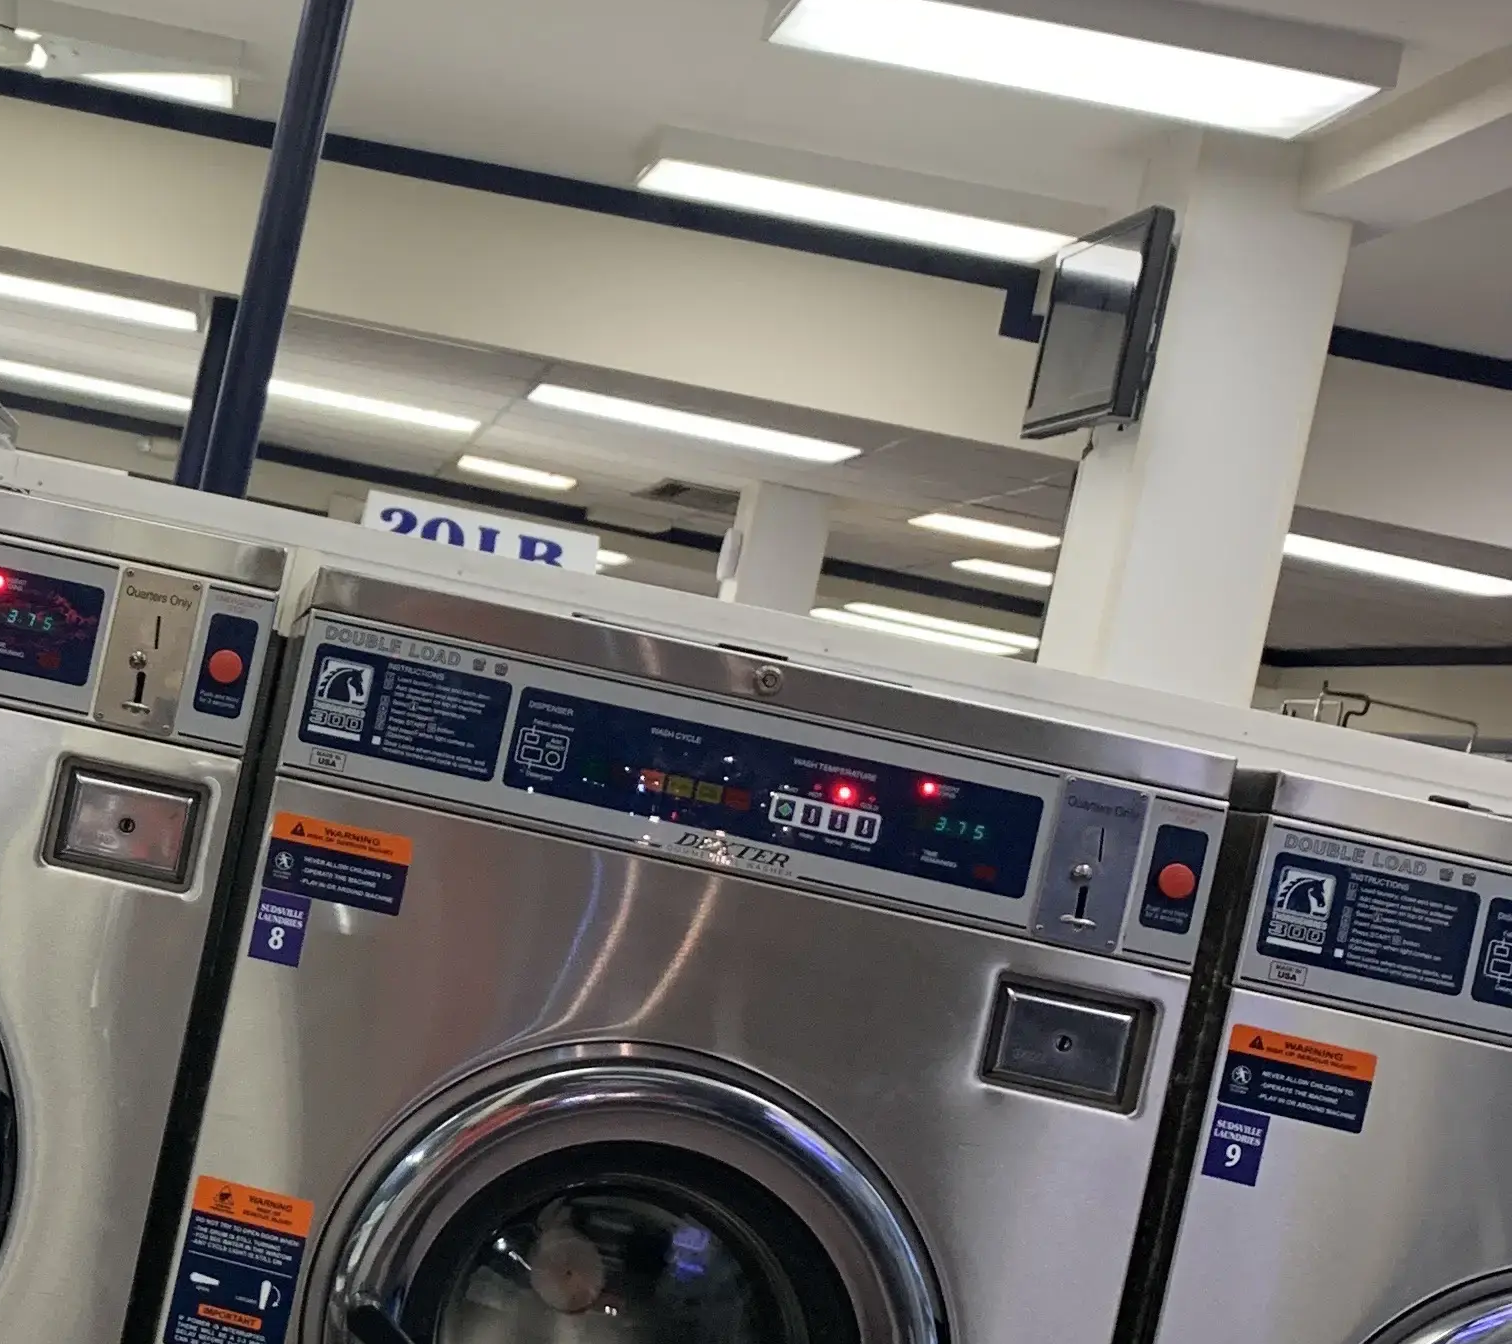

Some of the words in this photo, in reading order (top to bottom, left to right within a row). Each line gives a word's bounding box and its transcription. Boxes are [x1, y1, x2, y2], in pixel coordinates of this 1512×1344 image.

[126, 586, 167, 603] Quarters
[170, 595, 192, 611] Only
[8, 609, 52, 630] 3.75
[326, 626, 402, 655] DOUBLE
[408, 644, 462, 667] LOAD
[388, 662, 444, 680] INSTRUCTIONS
[529, 700, 574, 717] DISPENSER
[309, 709, 363, 733] 300
[652, 728, 674, 738] WASH
[676, 732, 701, 744] CYCLE
[318, 758, 336, 767] USA
[325, 828, 380, 846] WARNING
[1284, 833, 1365, 864] DOUBLE
[1372, 852, 1428, 878] LOAD
[1351, 873, 1410, 891] INSTRUCTIONS
[258, 912, 303, 929] LAUNDRIES
[261, 904, 303, 919] SUDSVILLE
[267, 926, 286, 950] 8
[1278, 971, 1297, 981] USA
[1286, 1041, 1343, 1060] WARNING
[1262, 1071, 1284, 1080] NEVER
[1285, 1076, 1309, 1085] ALLOW
[1310, 1082, 1343, 1093] CHILDREN
[1216, 1120, 1262, 1136] SUDSVILLE
[1213, 1129, 1261, 1146] LAUNDRIES
[1224, 1144, 1242, 1167] 9
[203, 1308, 256, 1326] IMPORTANT
